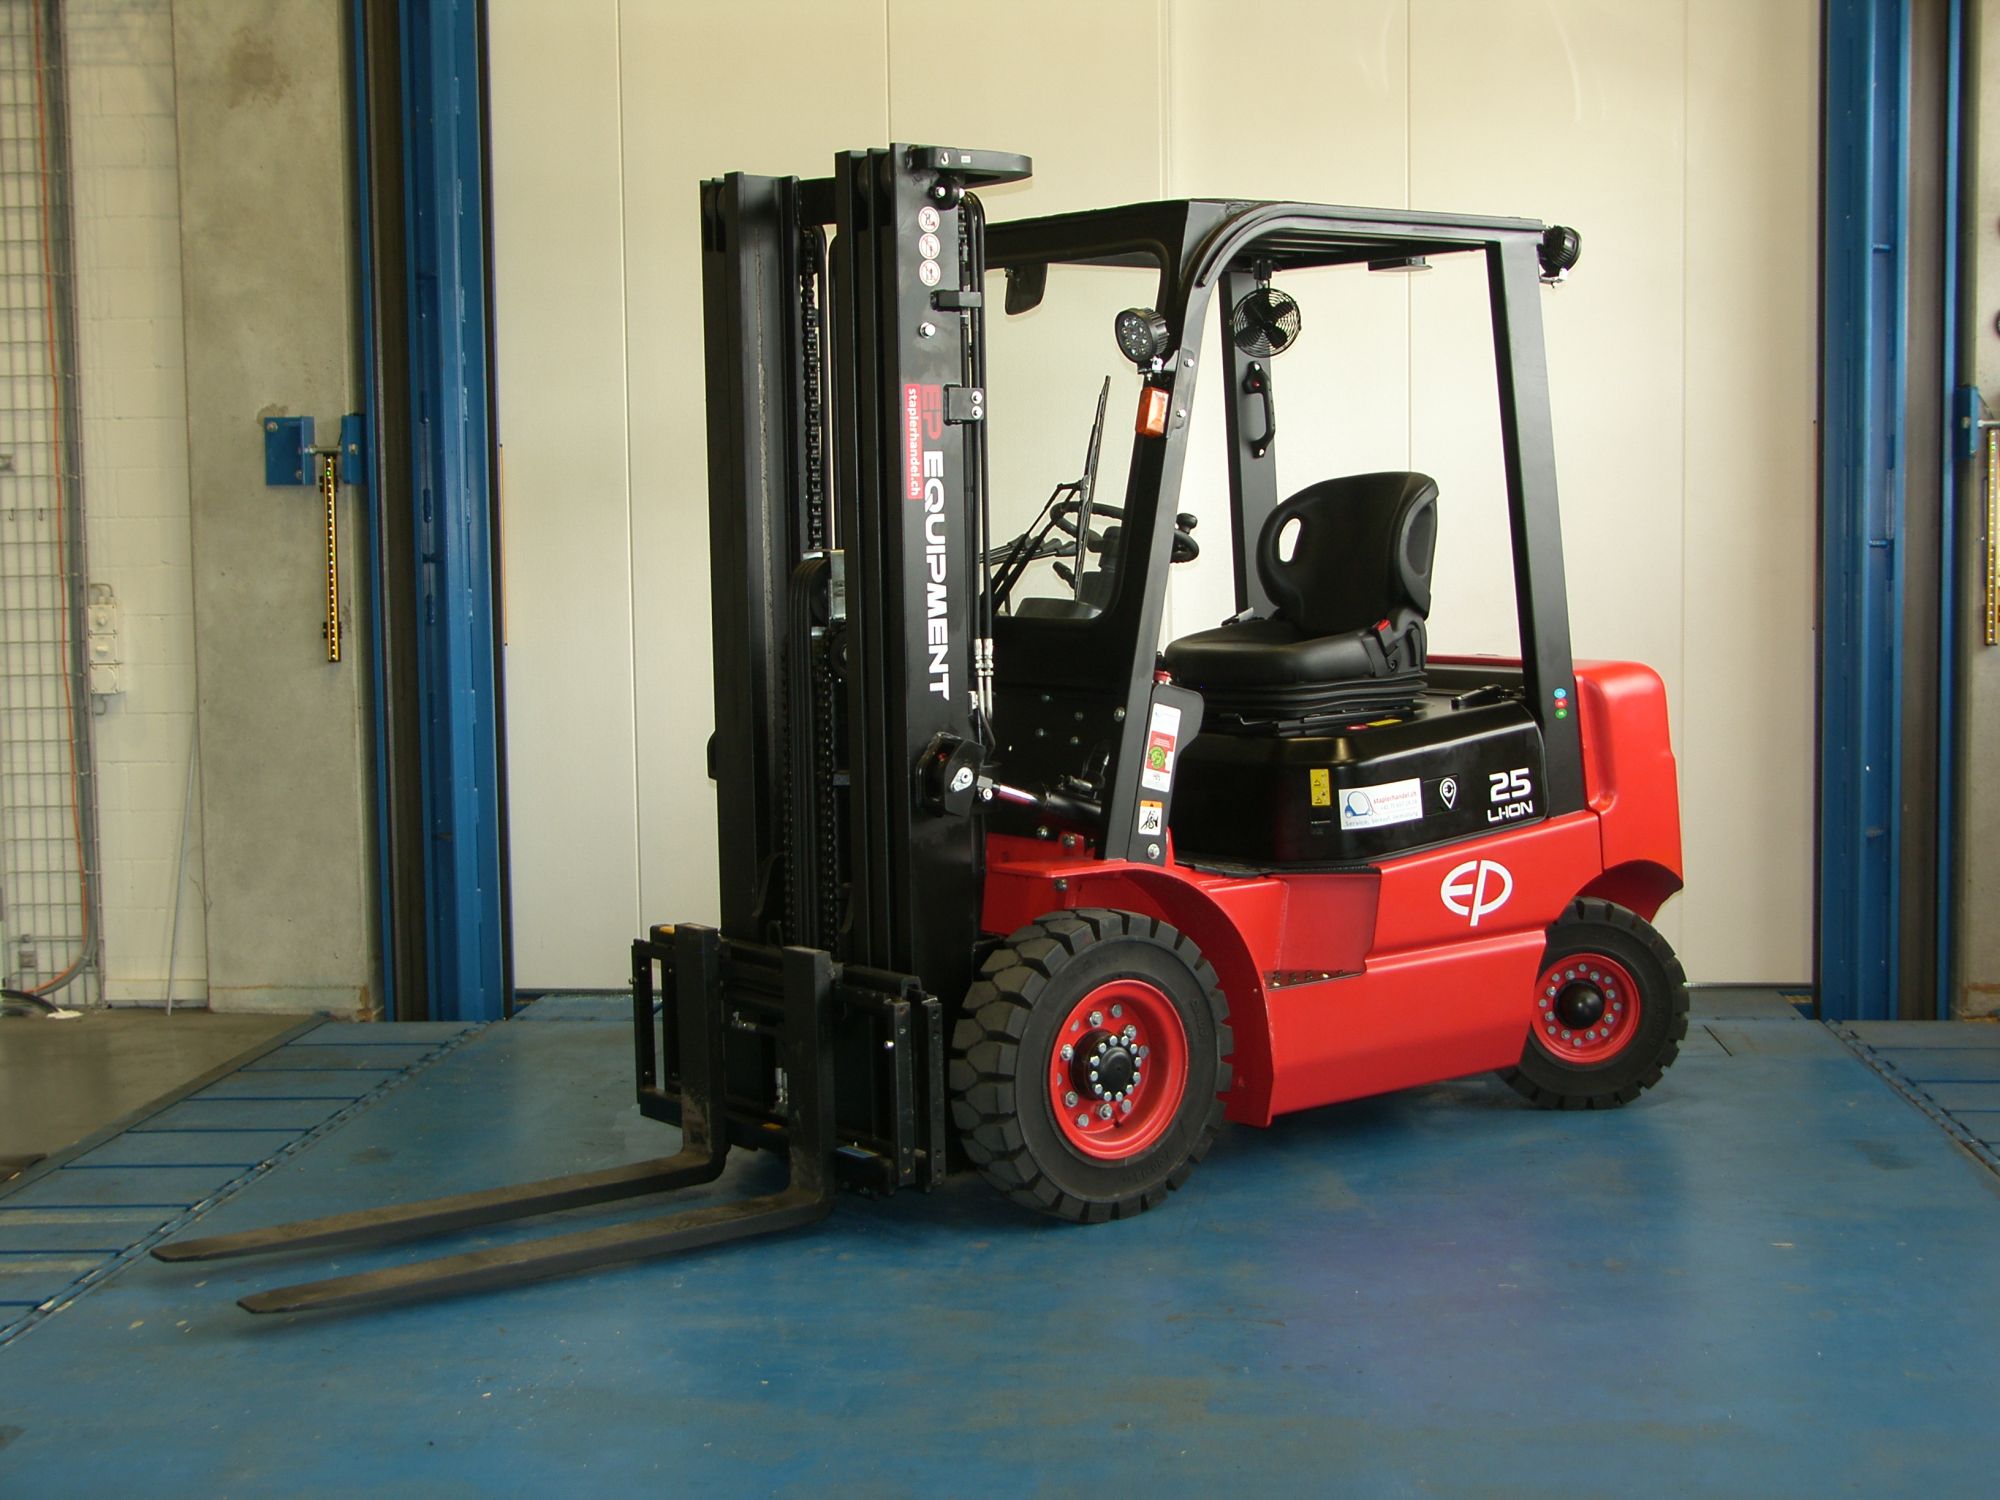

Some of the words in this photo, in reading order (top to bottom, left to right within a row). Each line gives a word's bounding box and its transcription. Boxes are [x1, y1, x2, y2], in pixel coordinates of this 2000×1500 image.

[907, 387, 921, 497] staplerhandel.ch
[922, 384, 942, 440] EP
[923, 450, 950, 701] EQUIPMENT
[1489, 767, 1532, 802] 25
[1440, 859, 1513, 927] EP
